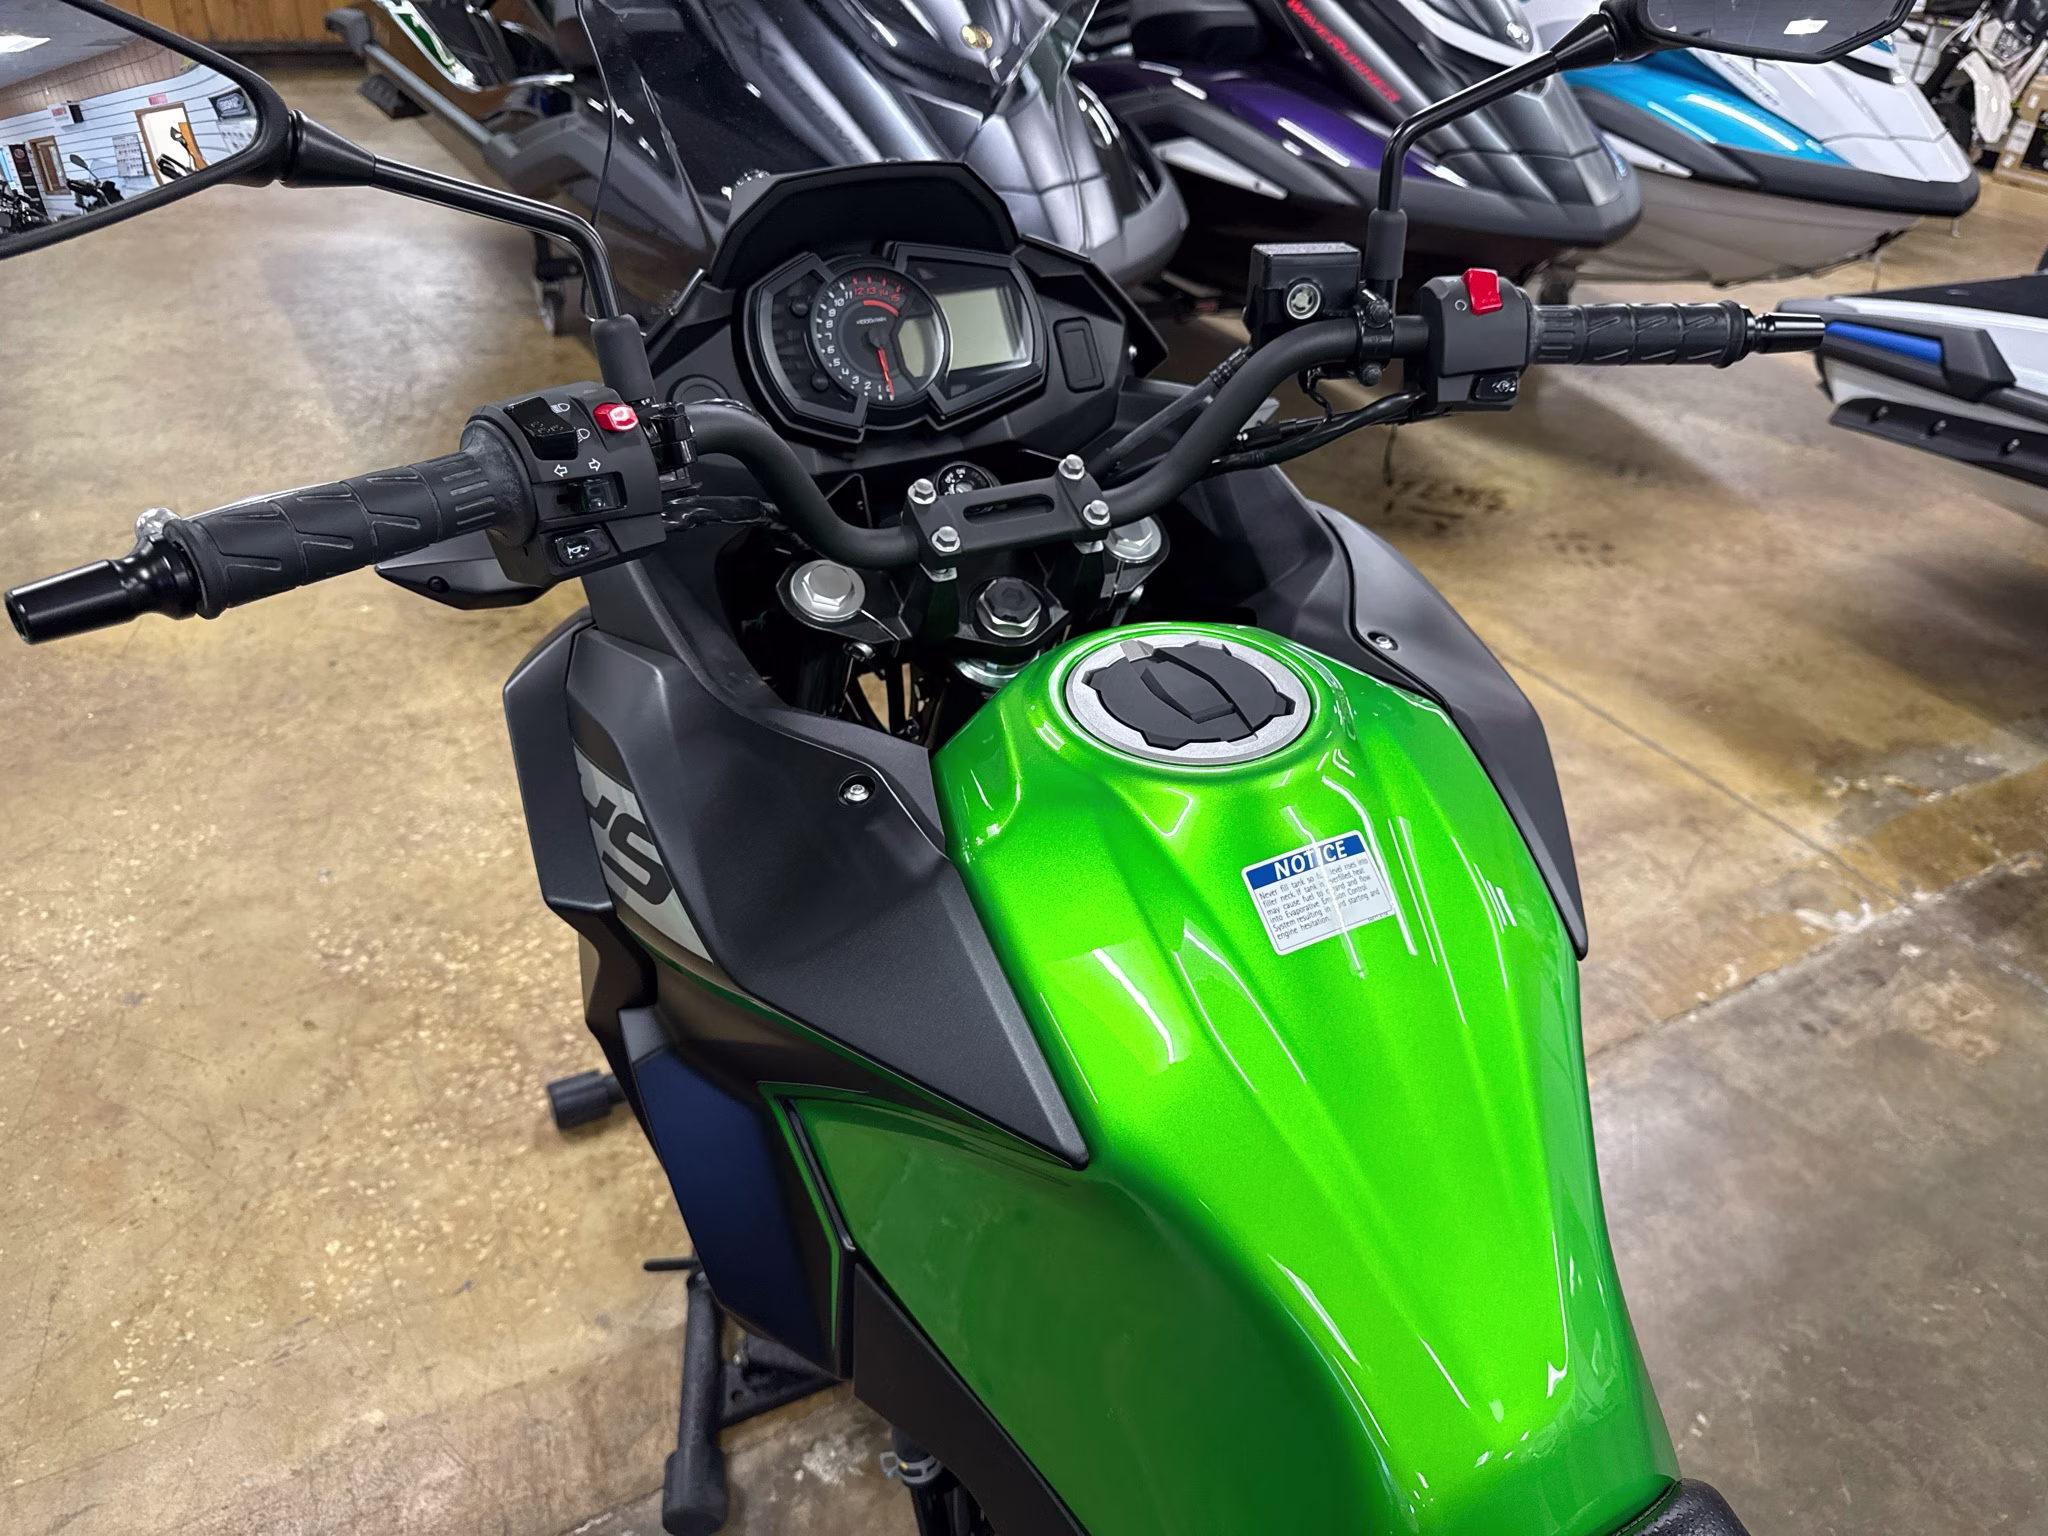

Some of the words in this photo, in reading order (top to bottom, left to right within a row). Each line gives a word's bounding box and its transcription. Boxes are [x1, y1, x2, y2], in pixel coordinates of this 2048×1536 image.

[854, 287, 865, 296] 12
[866, 286, 876, 294] 13
[844, 290, 853, 300] 11
[890, 294, 900, 302] 15
[834, 298, 845, 307] 10
[828, 308, 836, 317] 9
[825, 320, 834, 328] 8
[824, 332, 832, 340] 7
[827, 345, 836, 354] 6
[832, 358, 841, 367] 5
[841, 368, 850, 376] 4
[852, 375, 860, 385] 3
[864, 381, 872, 390] 2
[1274, 840, 1348, 880] NOTICE
[1259, 889, 1278, 900] Never
[1280, 884, 1289, 892] fill
[1291, 878, 1305, 888] tank
[1329, 865, 1342, 874] level
[1262, 898, 1278, 908] filler
[1304, 884, 1318, 892] tank
[1328, 872, 1353, 883] verfilled,
[1352, 868, 1365, 876] heat
[1267, 907, 1280, 916] may
[1283, 900, 1300, 910] cause
[1302, 893, 1314, 902] fuel
[1326, 882, 1346, 894] eand
[1347, 878, 1358, 887] and
[1270, 914, 1284, 924] into
[1285, 902, 1320, 918] Evaporative
[1321, 892, 1346, 905] Emion
[1347, 884, 1368, 896] Control
[1272, 919, 1296, 932] System
[1296, 910, 1324, 924] resulting
[1348, 893, 1370, 905] starting
[1370, 888, 1380, 897] and
[1277, 928, 1298, 940] engine
